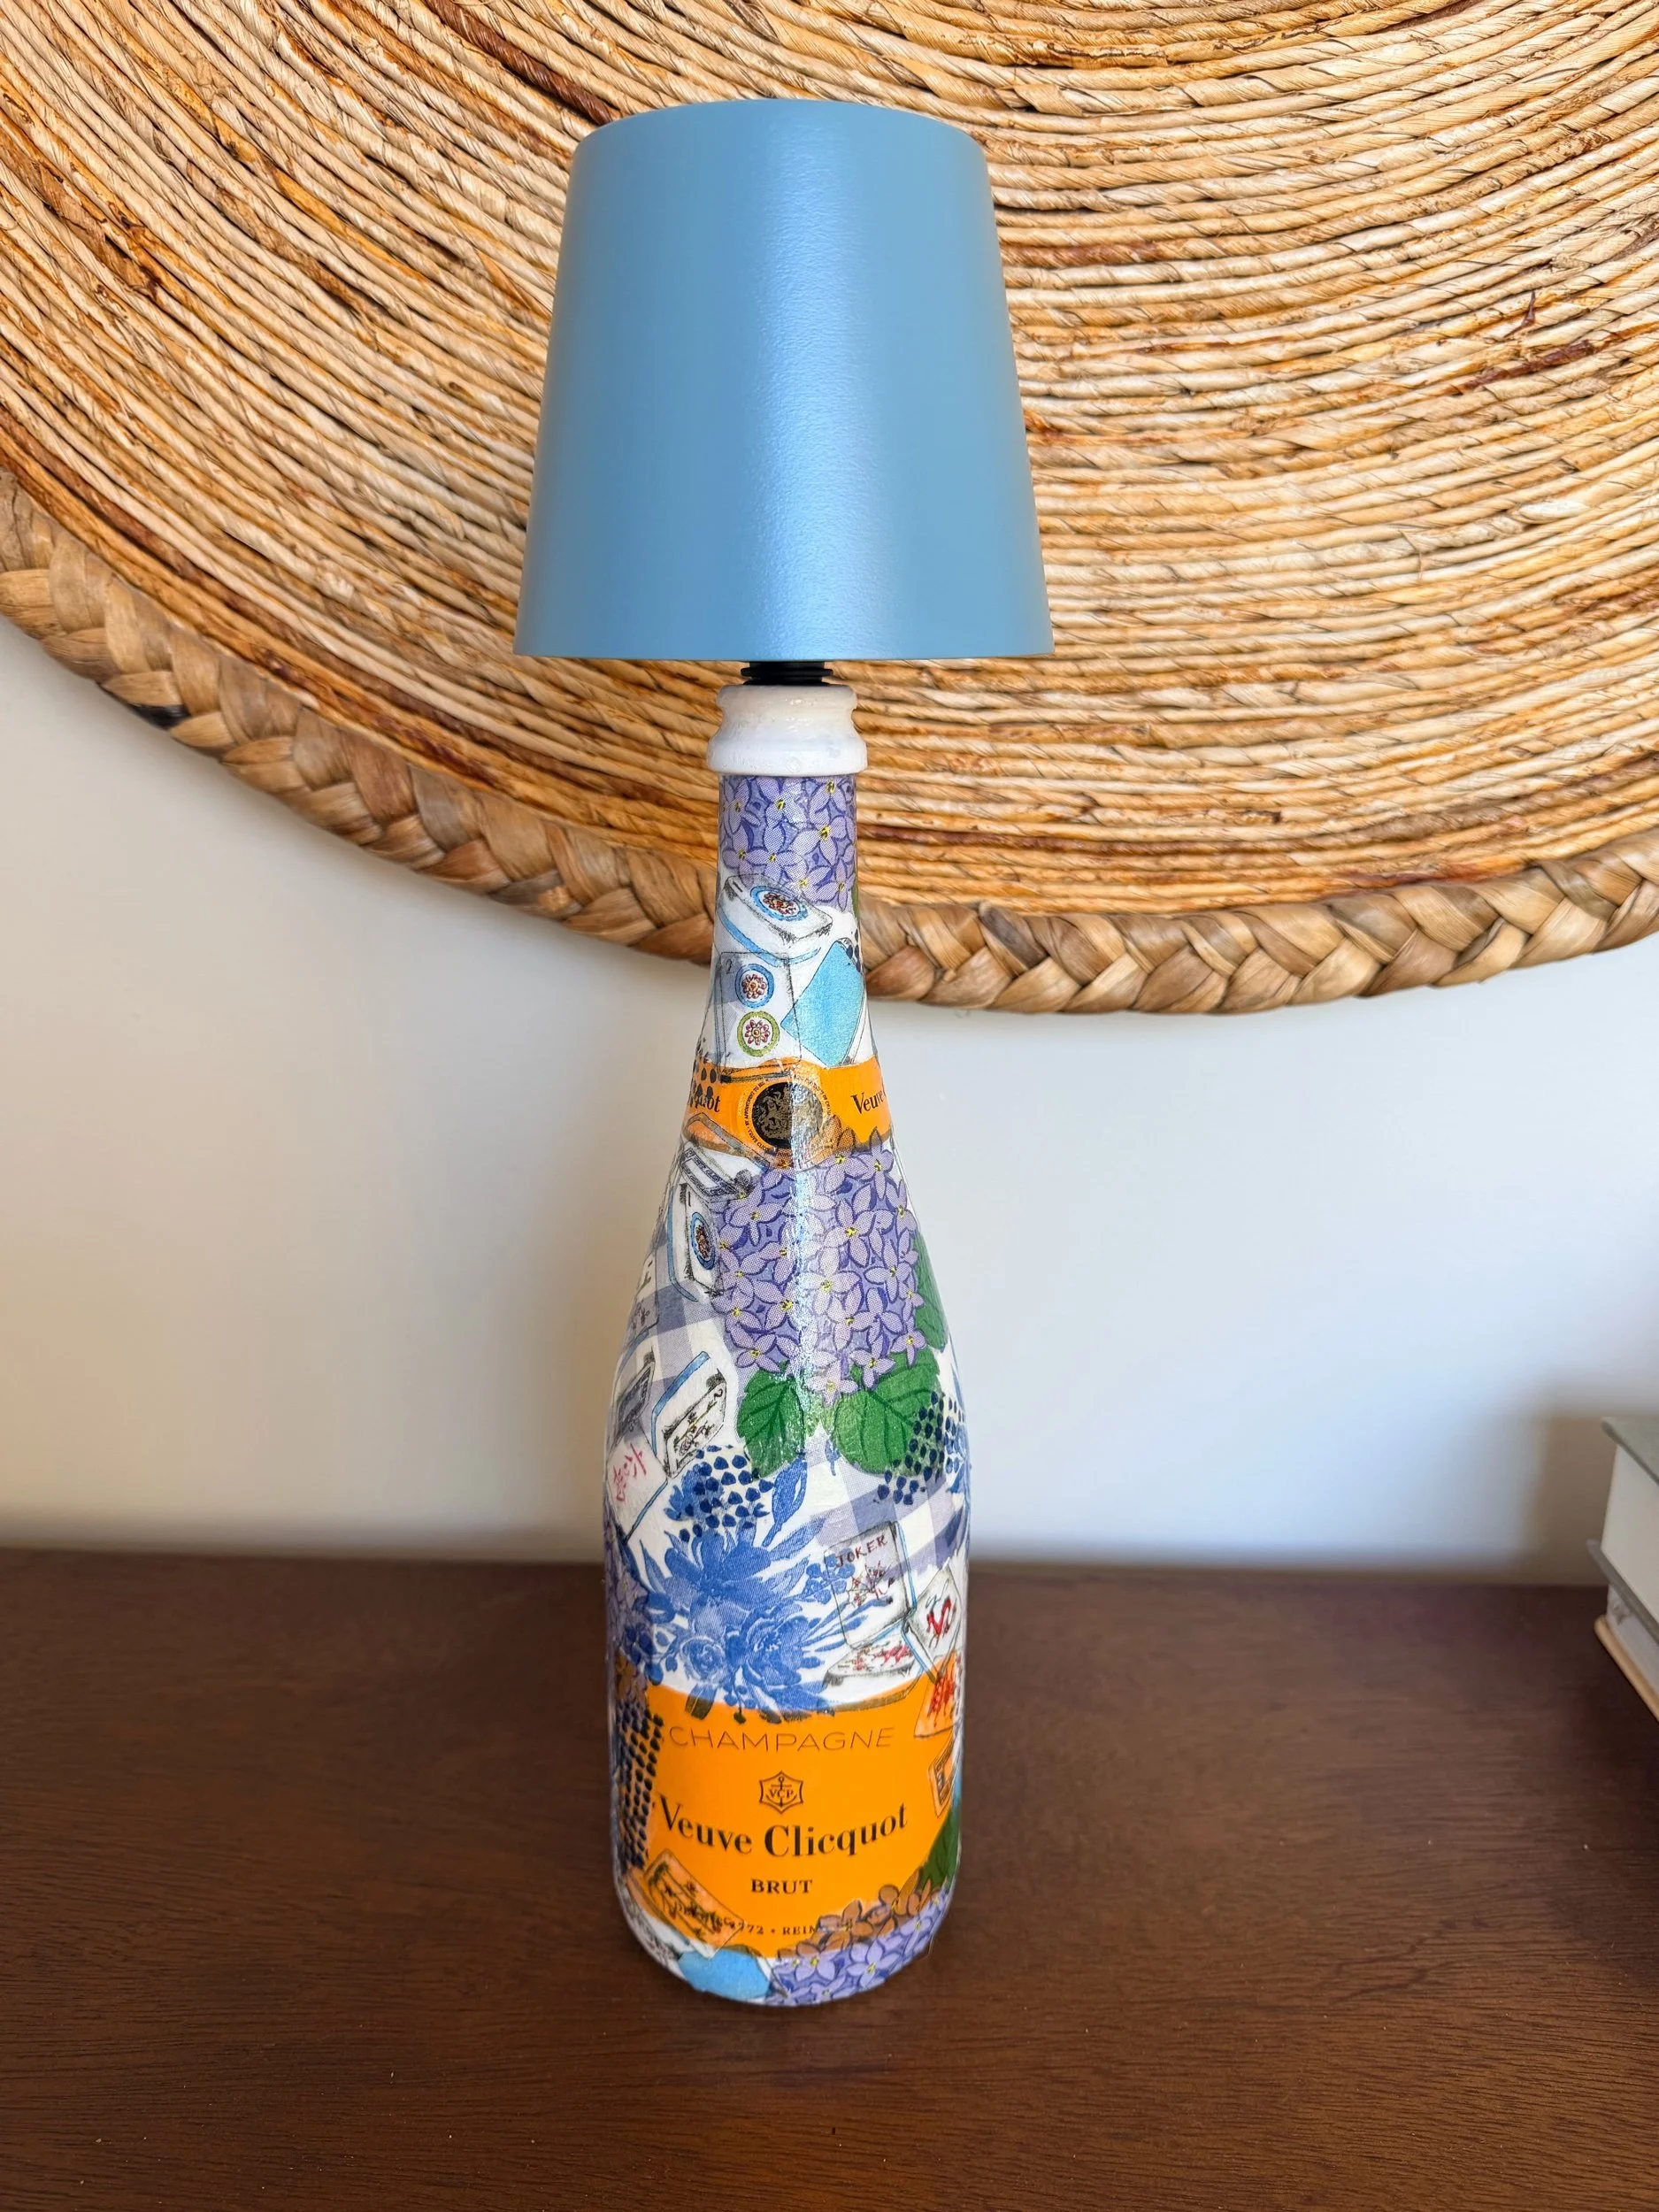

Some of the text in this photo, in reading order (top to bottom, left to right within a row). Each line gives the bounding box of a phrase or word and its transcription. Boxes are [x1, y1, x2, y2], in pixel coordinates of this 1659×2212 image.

[835, 1533, 888, 1569] JOKER
[669, 1725, 895, 1752] CHAMPAGNE
[659, 1792, 909, 1858] Veuve Clicquot
[750, 1878, 814, 1894] BRUT
